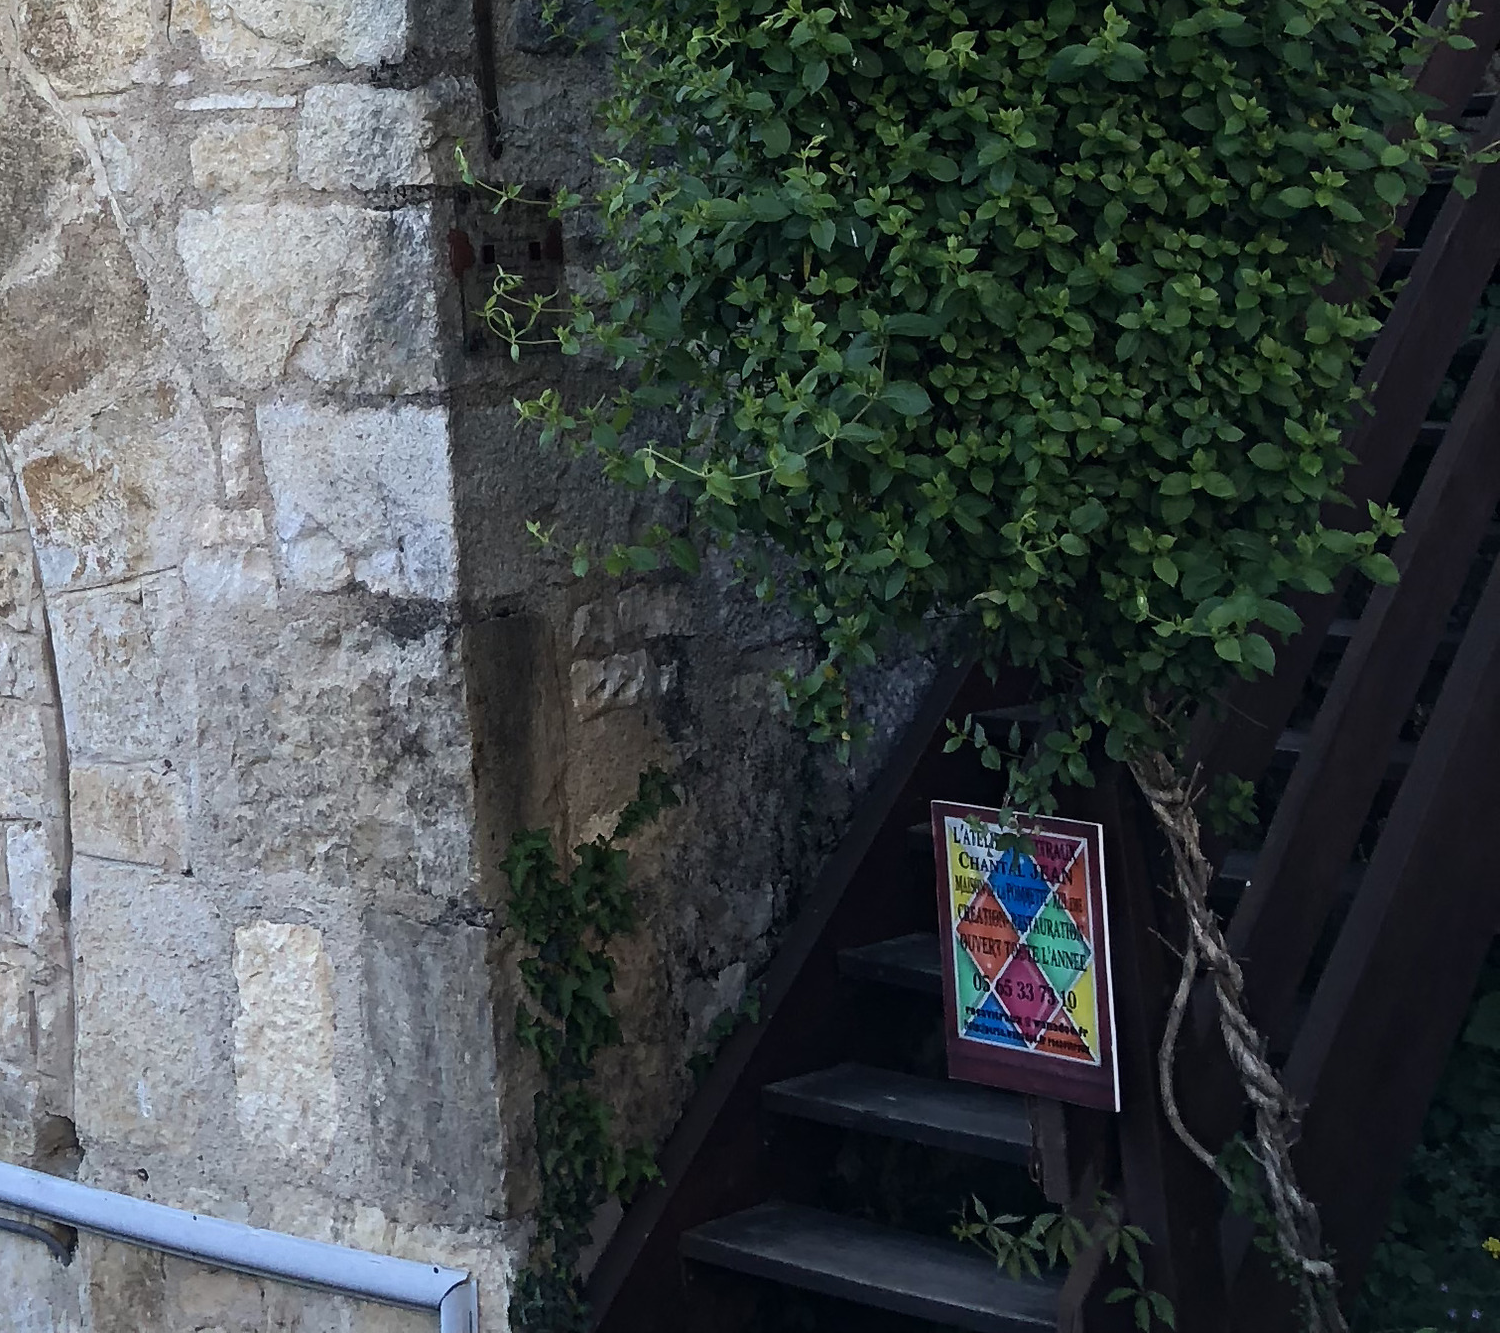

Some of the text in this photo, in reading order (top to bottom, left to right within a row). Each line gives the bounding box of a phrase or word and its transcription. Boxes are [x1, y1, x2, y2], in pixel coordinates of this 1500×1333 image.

[958, 851, 1073, 886] CHANTAL JEAN
[960, 934, 1002, 958] OUVERT
[994, 977, 1014, 998] 65
[1016, 980, 1035, 1003] 33
